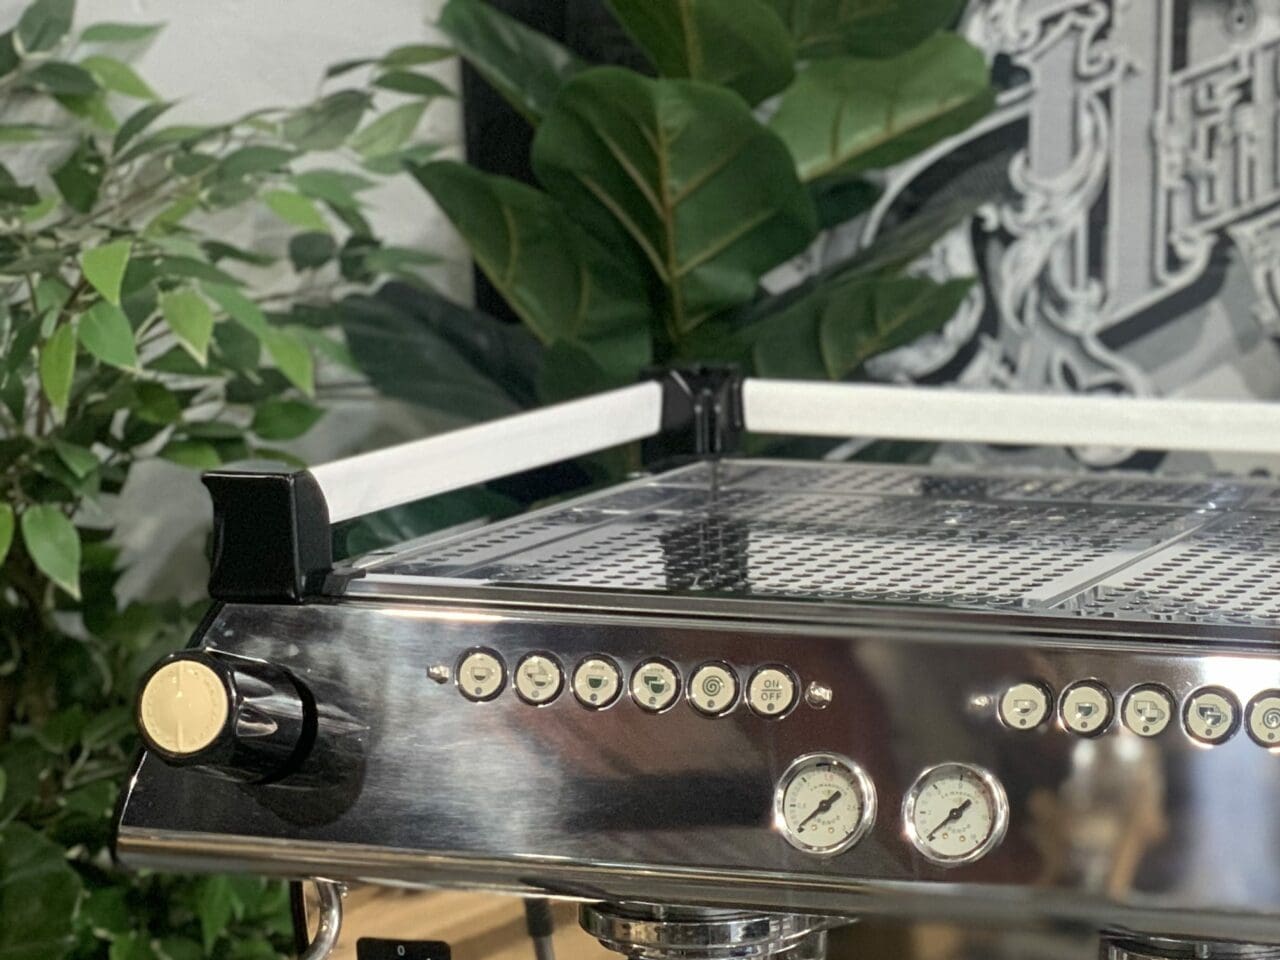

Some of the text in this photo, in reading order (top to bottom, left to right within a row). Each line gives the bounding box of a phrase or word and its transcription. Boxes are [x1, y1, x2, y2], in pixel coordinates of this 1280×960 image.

[763, 679, 780, 689] ON
[760, 692, 782, 702] OFF
[396, 944, 406, 957] 0
